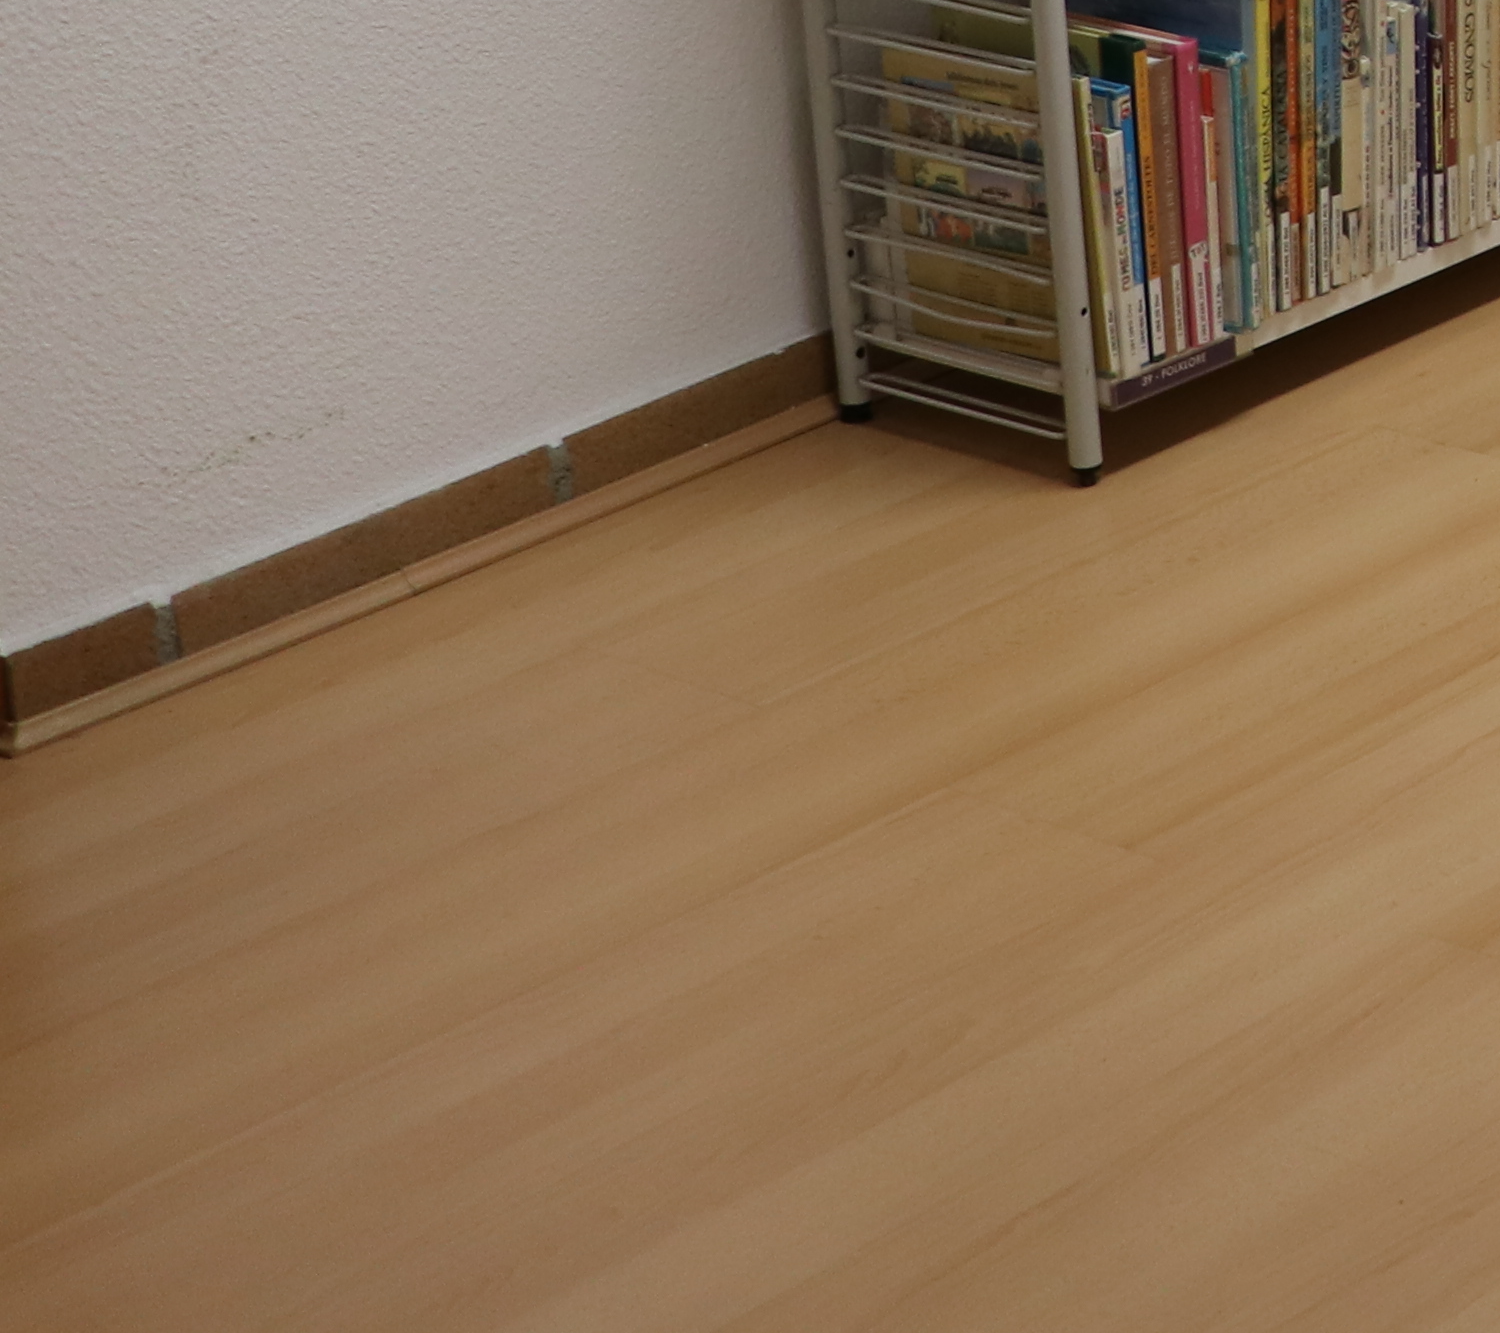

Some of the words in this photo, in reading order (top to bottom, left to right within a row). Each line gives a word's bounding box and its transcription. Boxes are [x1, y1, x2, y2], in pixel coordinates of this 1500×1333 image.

[1463, 15, 1477, 104] GNOMOS
[1139, 371, 1154, 388] 39
[1160, 351, 1209, 382] FOLKLORE
